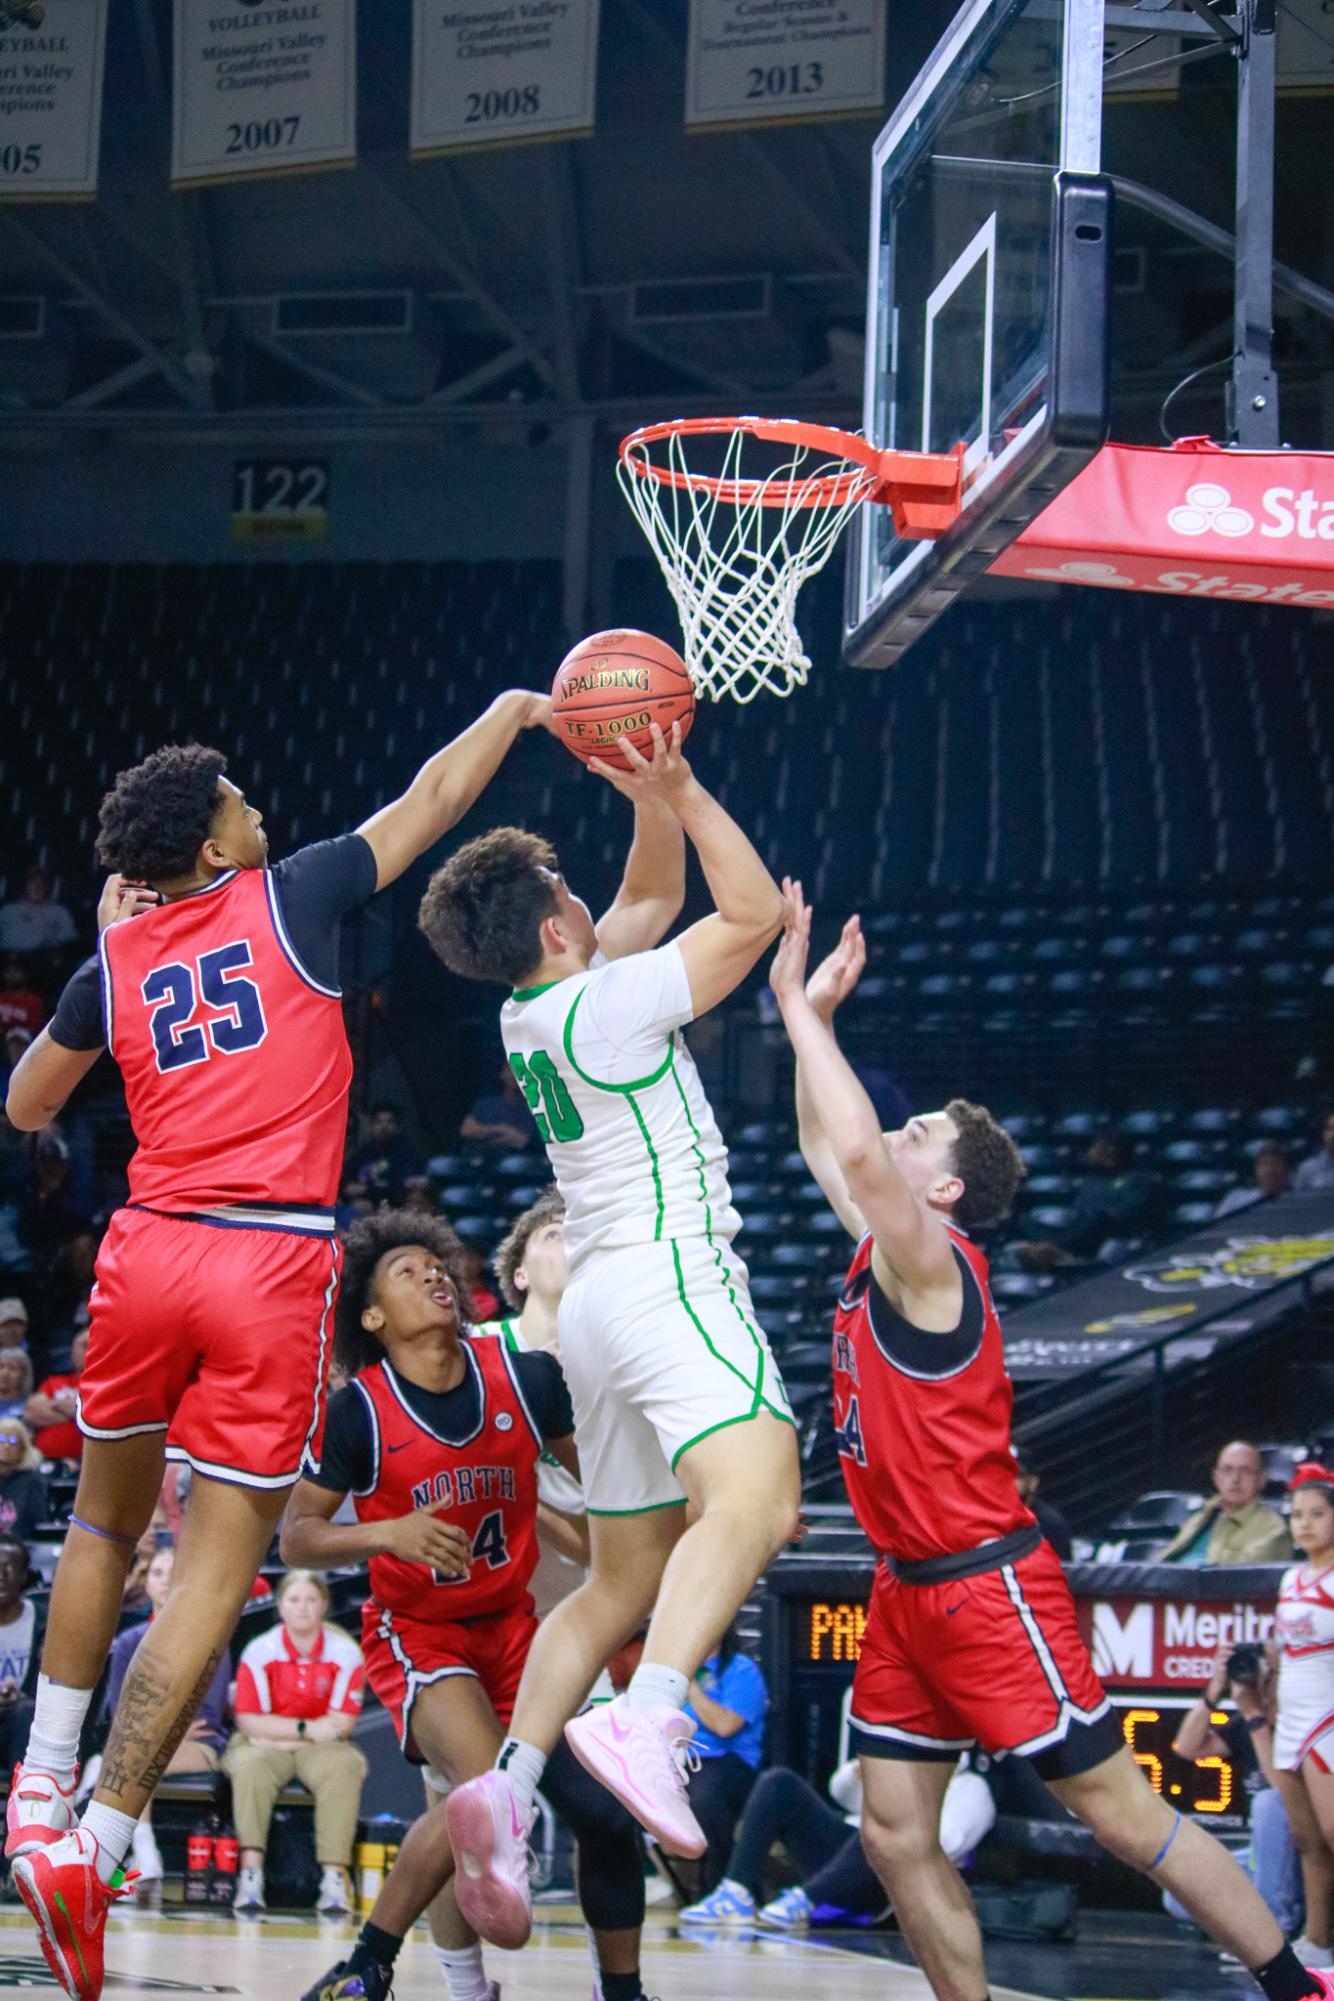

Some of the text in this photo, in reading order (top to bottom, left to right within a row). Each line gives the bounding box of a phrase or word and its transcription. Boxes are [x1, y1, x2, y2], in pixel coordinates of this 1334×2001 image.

[207, 6, 320, 32] VOLLEYBALL
[201, 32, 327, 61] Missouri Valley
[216, 52, 312, 74] Conference
[217, 70, 311, 92] Champions
[747, 61, 825, 98] 2013
[464, 85, 540, 123] 2008
[226, 115, 301, 154] 2007
[237, 466, 327, 516] 122
[1140, 571, 1334, 604] State
[560, 668, 650, 703] SPALDING
[140, 938, 269, 1075] 25
[508, 1049, 585, 1144] 20
[411, 1465, 516, 1511] NORTH
[431, 1508, 512, 1587] 4
